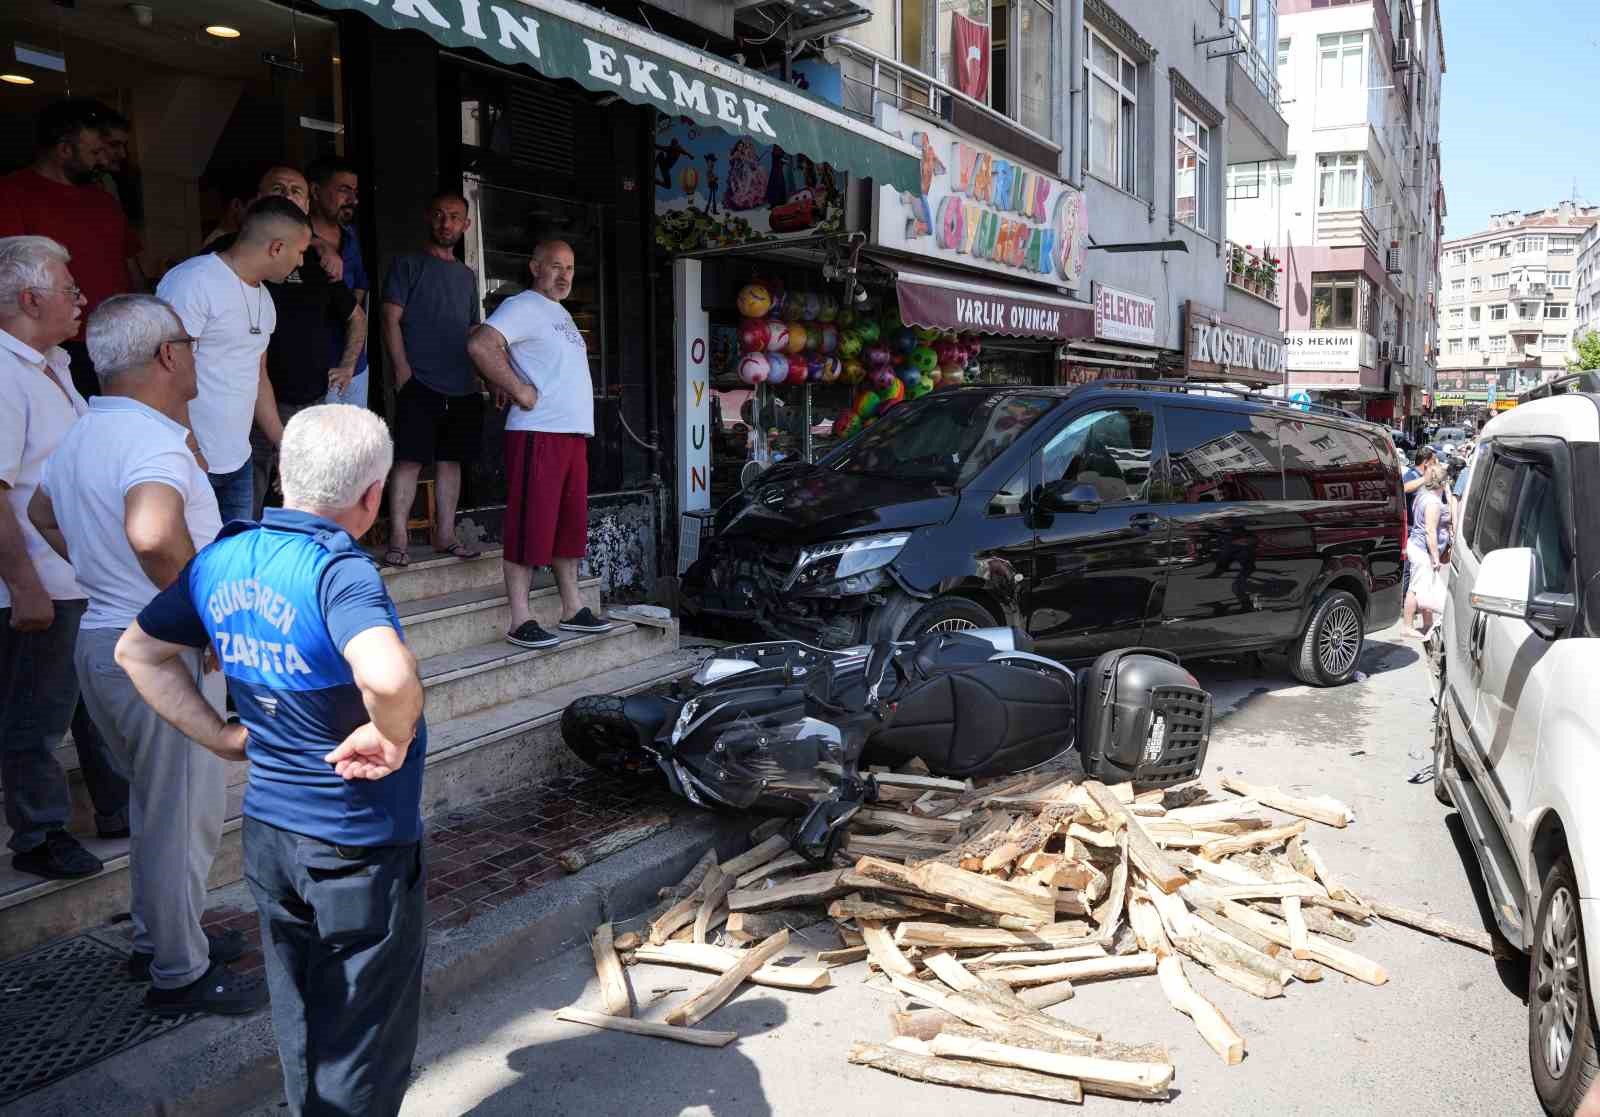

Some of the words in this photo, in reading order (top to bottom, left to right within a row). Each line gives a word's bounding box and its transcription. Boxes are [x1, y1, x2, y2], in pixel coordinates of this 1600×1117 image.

[364, 0, 541, 58] KIN
[584, 38, 777, 137] EKMEK
[952, 142, 1051, 225] VARLIK
[936, 196, 1056, 274] OYUNCAK
[956, 296, 1004, 328] VARLIK
[1010, 306, 1060, 335] OYUNCAK
[1284, 336, 1303, 346] DİŞ
[1309, 335, 1352, 346] HEKİMİ
[1258, 339, 1287, 373] GIDA
